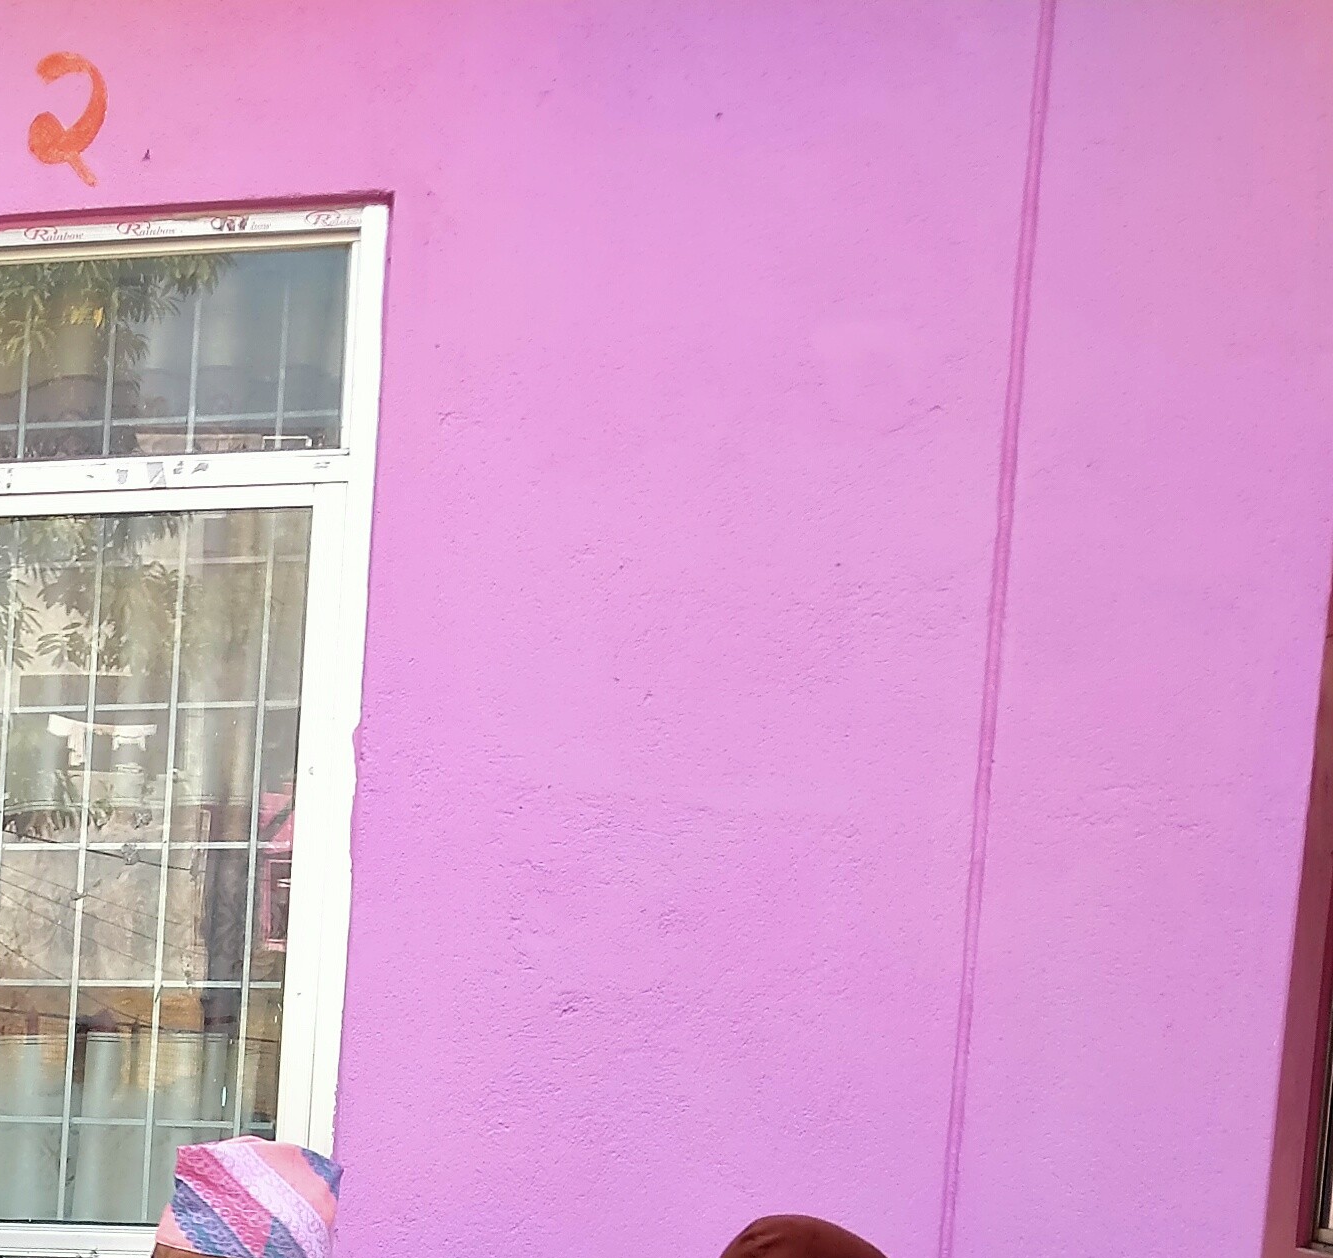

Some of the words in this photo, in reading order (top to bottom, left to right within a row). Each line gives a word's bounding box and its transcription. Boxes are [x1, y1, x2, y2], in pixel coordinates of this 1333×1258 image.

[28, 51, 108, 187] २
[24, 226, 84, 242] Rainbow
[116, 220, 177, 236] Rainbow
